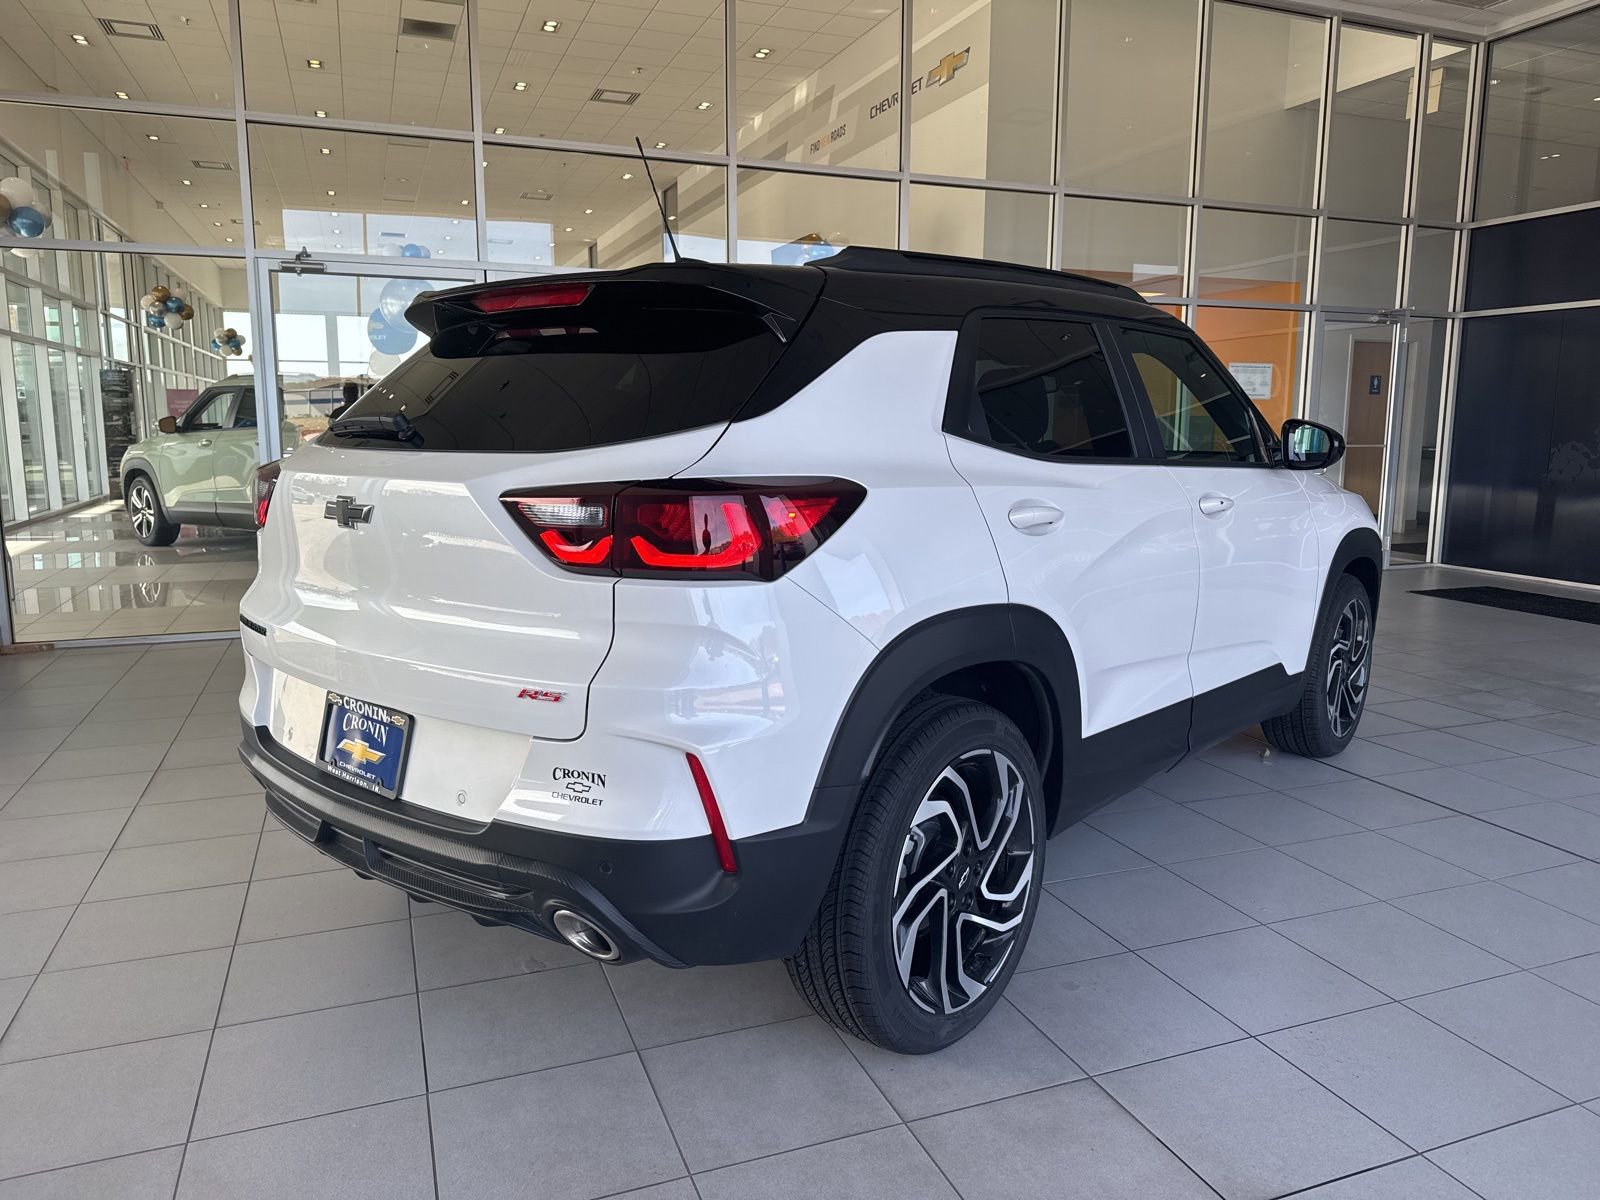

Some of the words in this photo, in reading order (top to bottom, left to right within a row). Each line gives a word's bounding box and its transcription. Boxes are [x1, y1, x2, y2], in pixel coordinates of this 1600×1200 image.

[870, 76, 923, 119] CHEVRET
[831, 124, 846, 143] ROADS
[517, 687, 567, 703] RS
[343, 696, 387, 722] CRONIN
[343, 712, 389, 748] CRONIN
[327, 764, 341, 776] West
[339, 761, 376, 780] CHEVROLET
[552, 766, 606, 789] CRONIN
[552, 791, 603, 806] CHEVROLET
